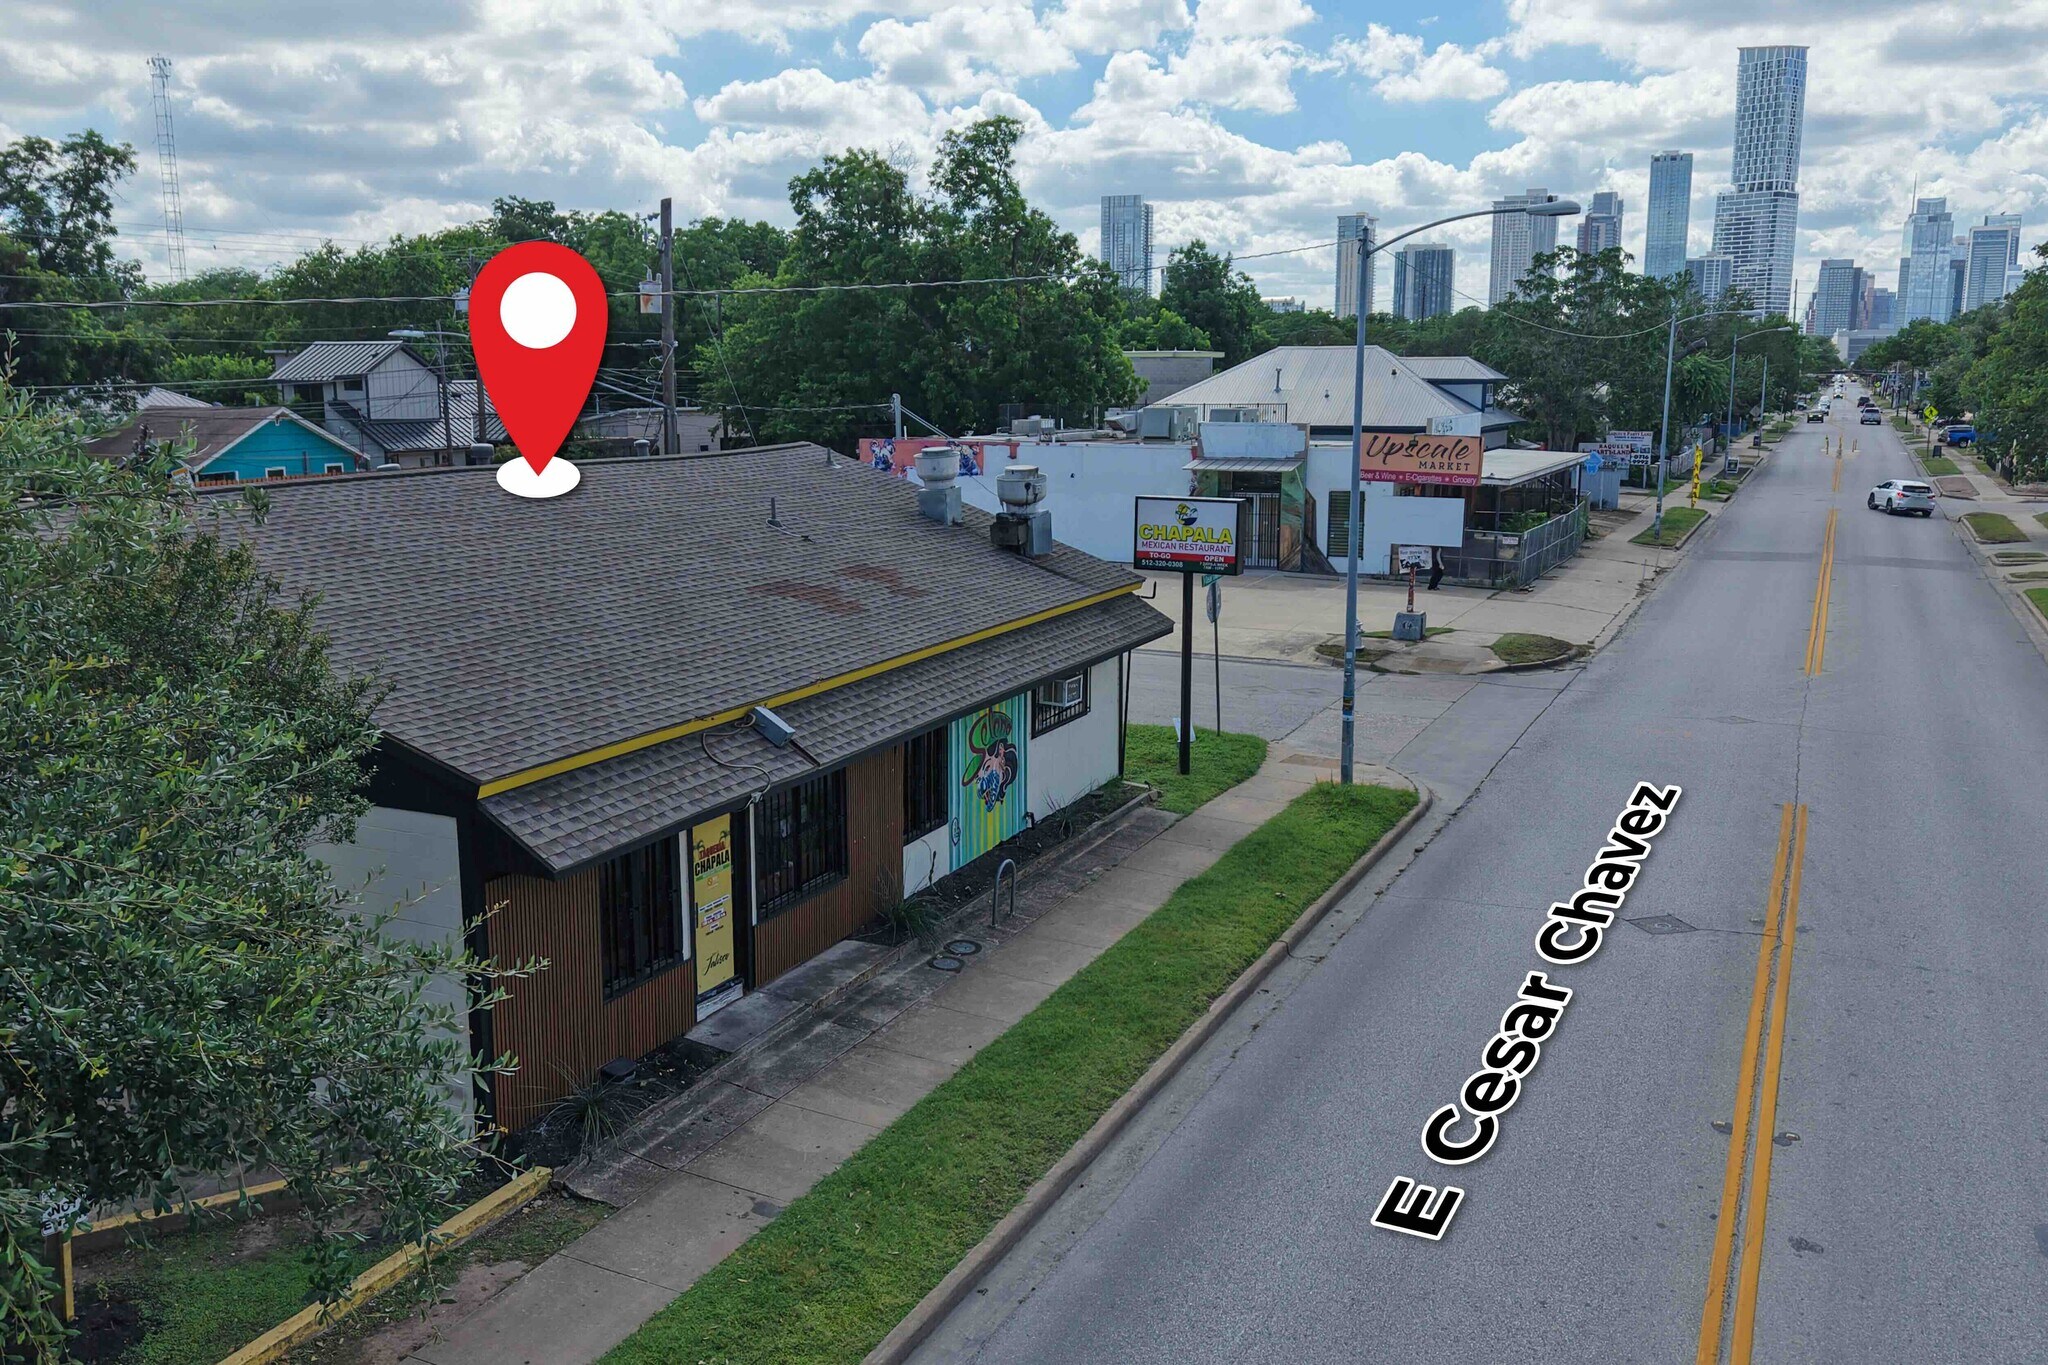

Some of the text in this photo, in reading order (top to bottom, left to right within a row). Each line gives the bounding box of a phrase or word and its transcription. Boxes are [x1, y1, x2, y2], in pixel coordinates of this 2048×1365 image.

[1366, 435, 1474, 465] Upscale
[1418, 461, 1471, 471] MARKET
[1360, 471, 1374, 479] Beer
[1381, 472, 1396, 480] Wine
[1405, 473, 1442, 483] E-Cigarettes
[1452, 475, 1477, 486] Grocery
[1138, 524, 1234, 544] CHAPALA
[1141, 541, 1231, 553] MEXICAN RESTAURANT
[1141, 559, 1184, 568] 512-320-0308
[694, 849, 730, 876] CHAPALA
